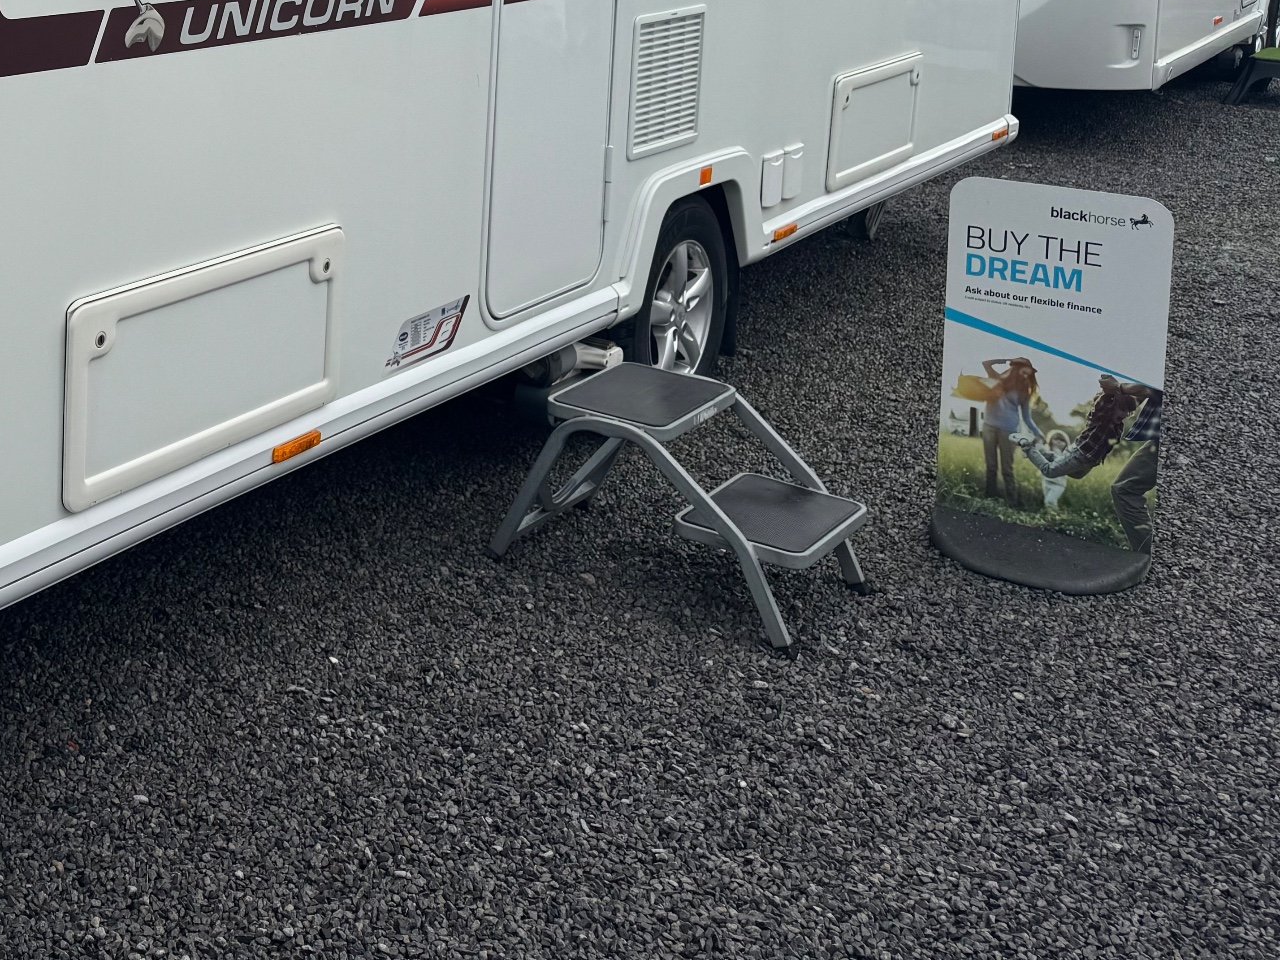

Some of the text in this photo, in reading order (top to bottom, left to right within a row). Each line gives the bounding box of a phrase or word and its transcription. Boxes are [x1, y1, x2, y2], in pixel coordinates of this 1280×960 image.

[1050, 206, 1126, 227] blackhorse
[966, 225, 1103, 268] BUY THE
[965, 252, 1083, 293] DREAM
[965, 285, 982, 296] Ask
[983, 287, 1011, 300] about
[1012, 293, 1029, 303] our
[1030, 295, 1065, 309] flexible
[1067, 301, 1103, 315] finance
